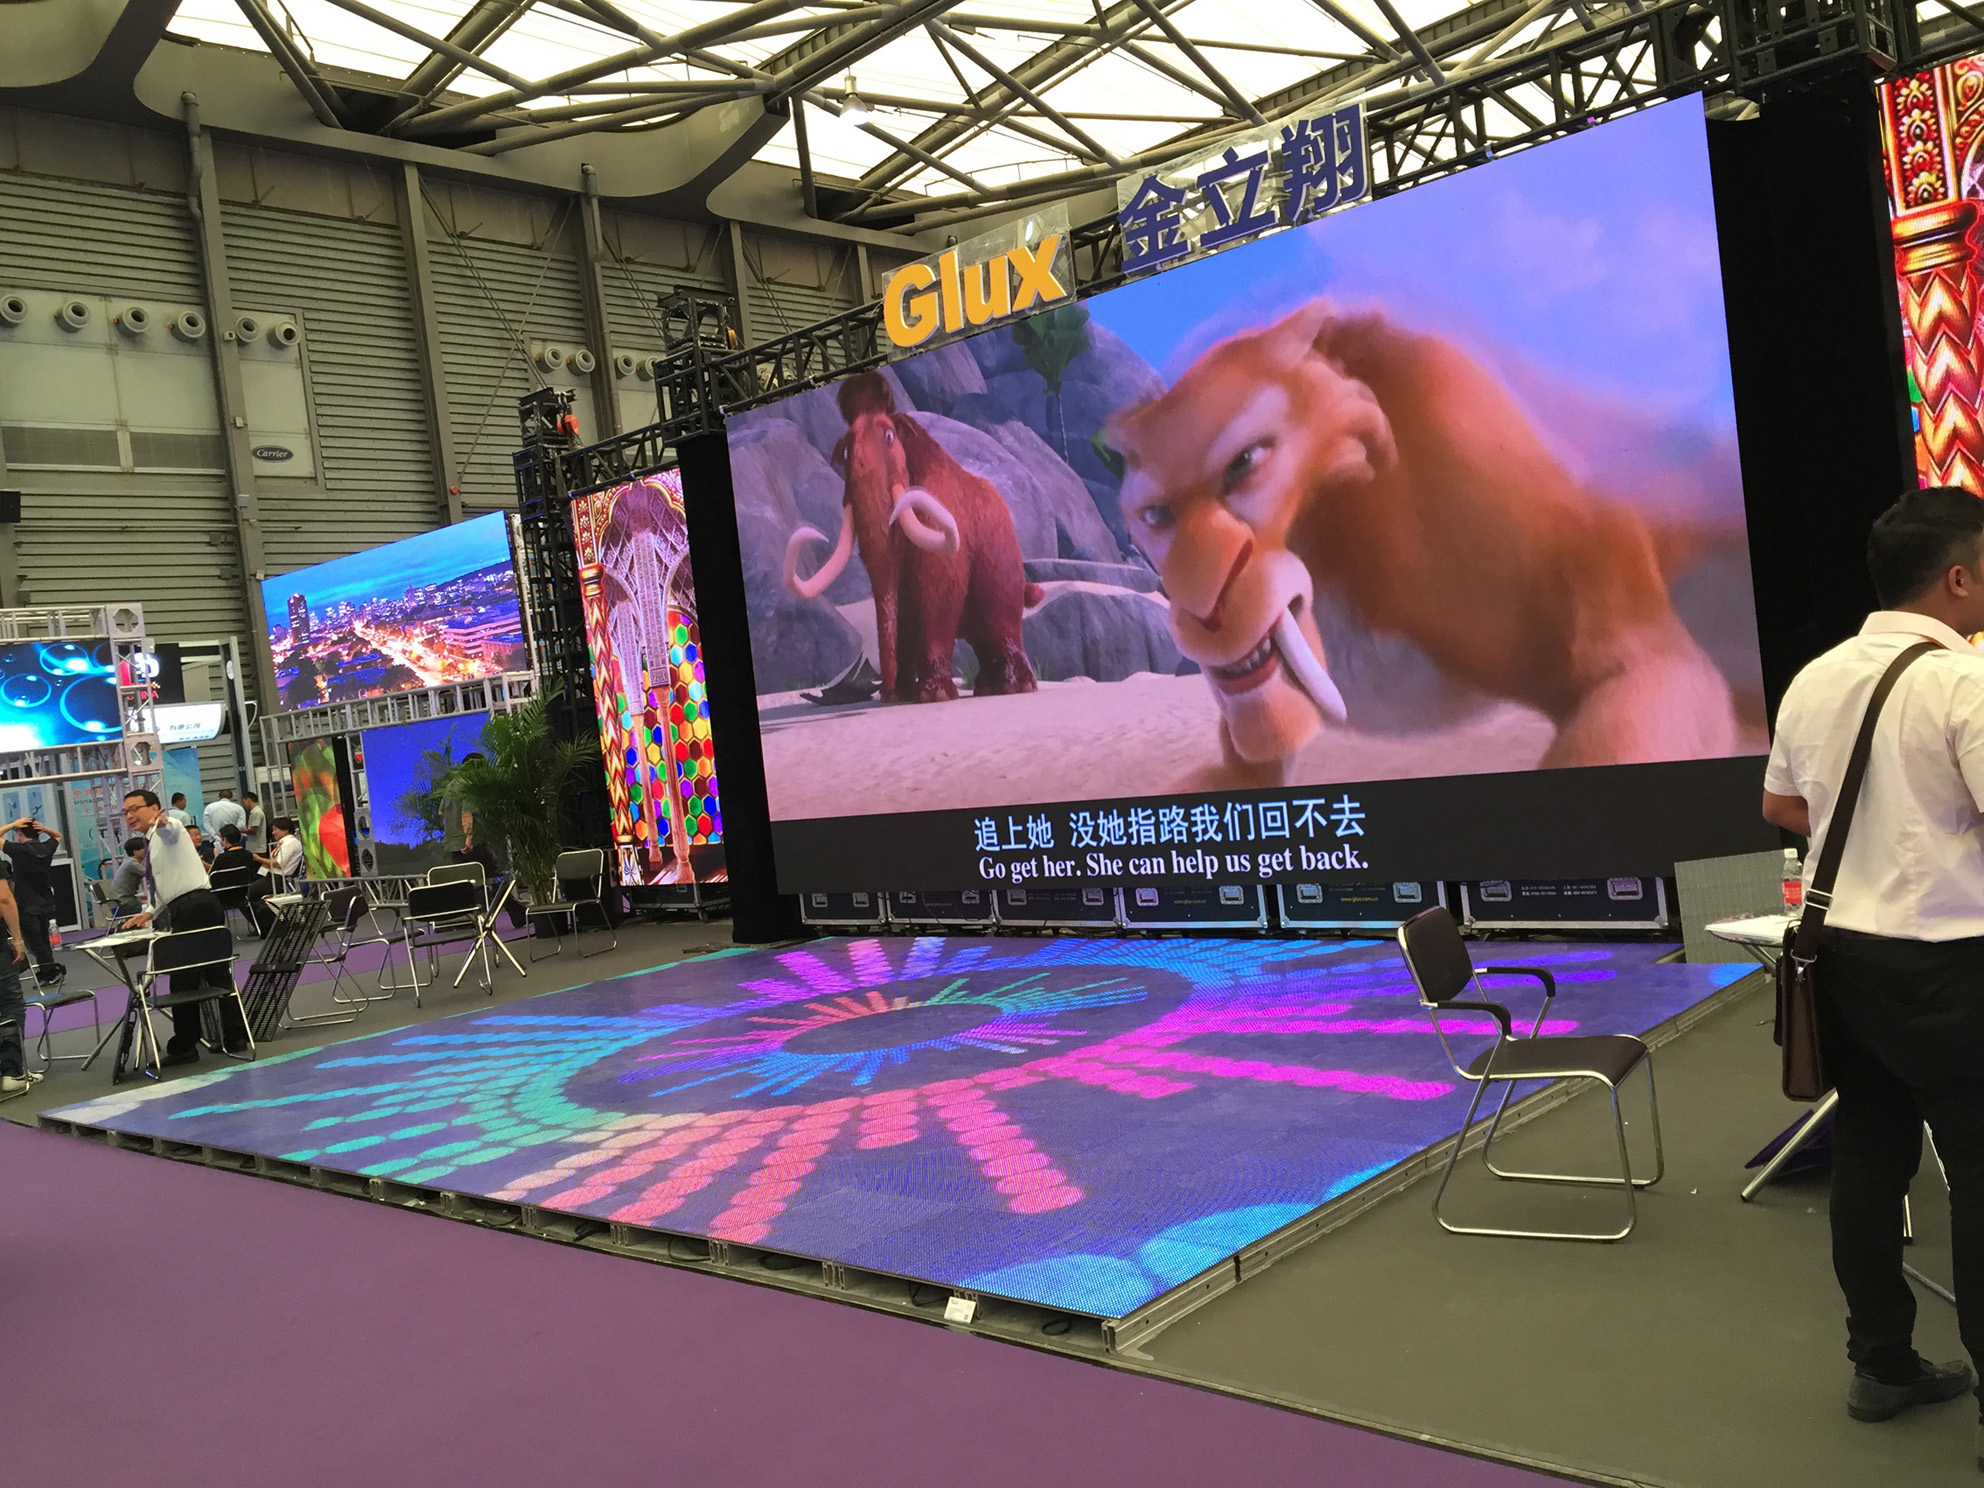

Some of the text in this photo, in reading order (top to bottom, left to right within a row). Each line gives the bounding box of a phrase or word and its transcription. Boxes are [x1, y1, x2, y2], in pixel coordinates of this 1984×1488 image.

[1117, 102, 1367, 274] 金立翔
[883, 234, 1068, 348] Glux
[256, 449, 288, 458] Carrier
[974, 794, 1366, 852] 追上她 没她指路我们回不去
[979, 843, 1369, 884] Go get her. She can help us get back.
